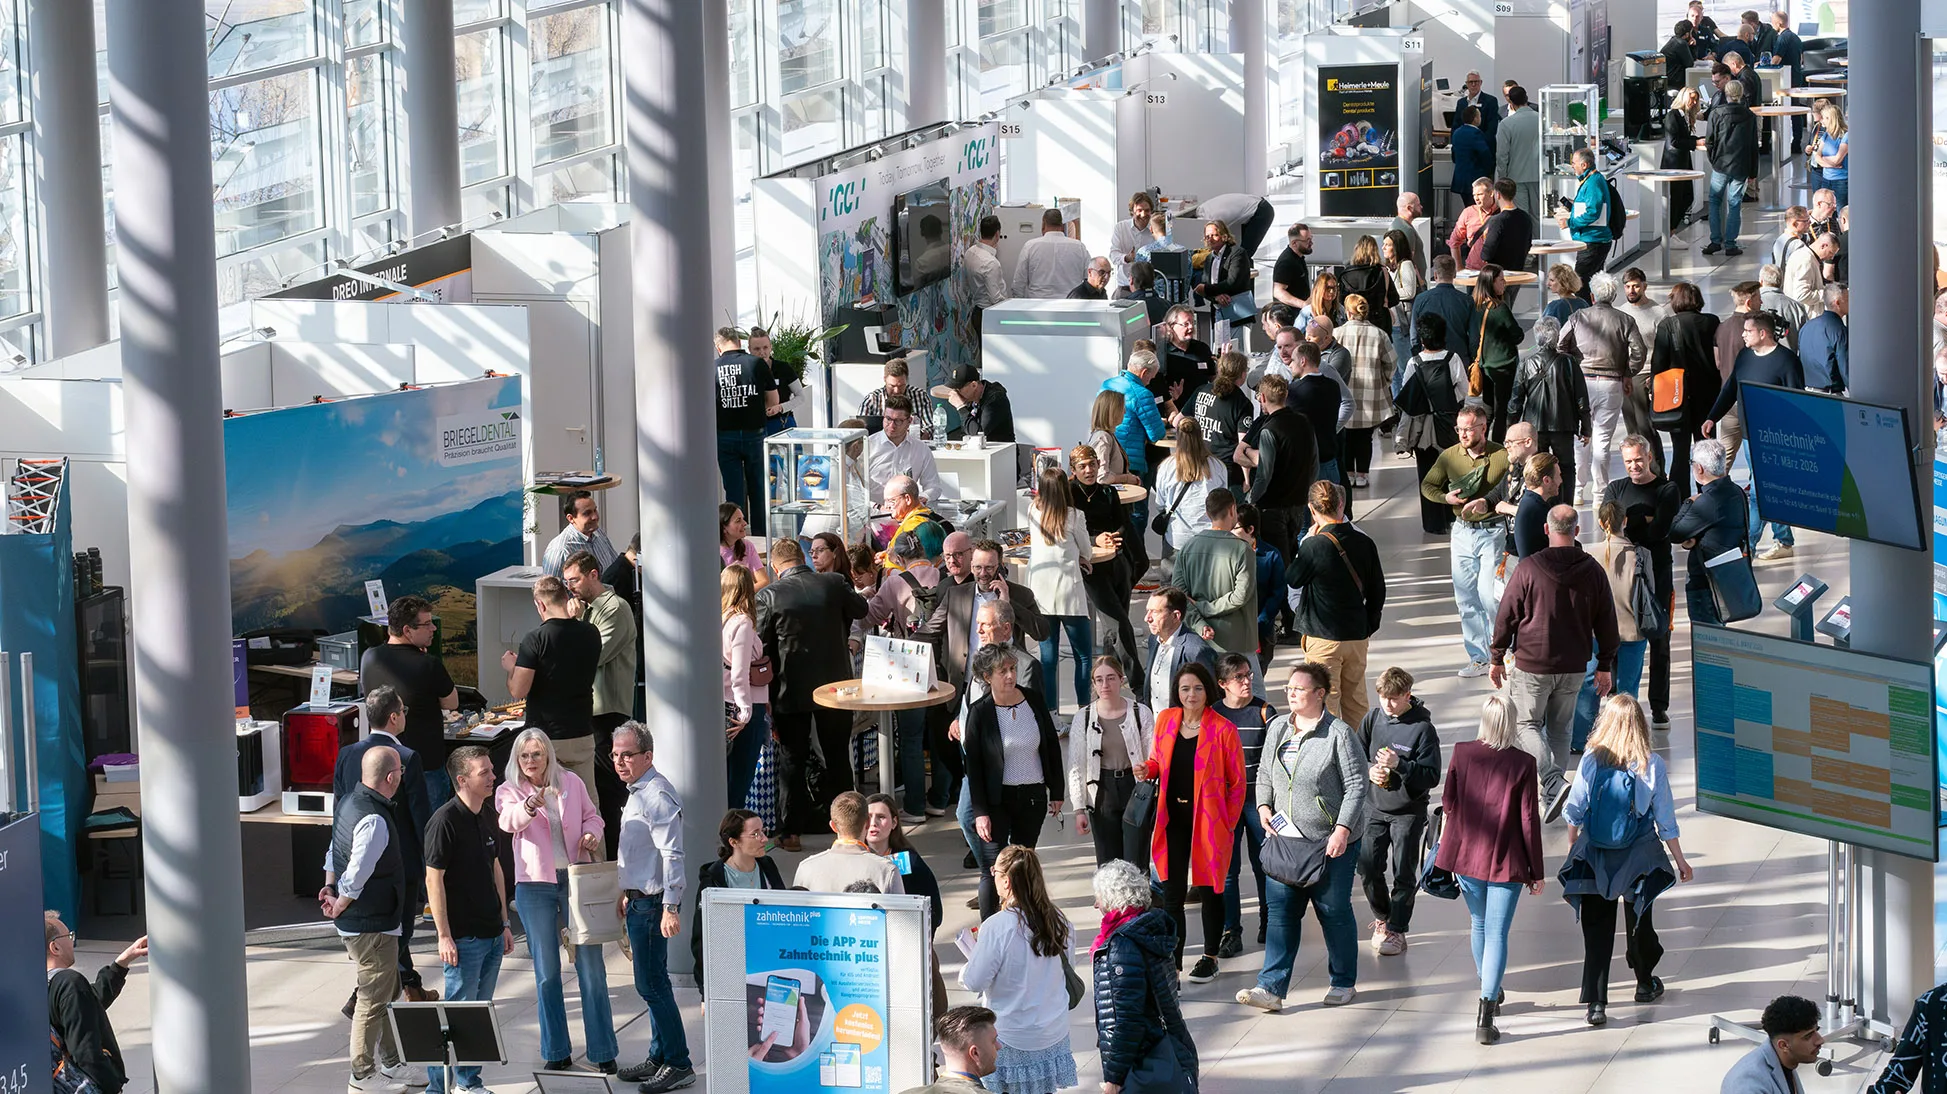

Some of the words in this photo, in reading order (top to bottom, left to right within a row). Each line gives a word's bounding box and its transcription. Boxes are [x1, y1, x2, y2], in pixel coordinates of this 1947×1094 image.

[1496, 4, 1511, 12] S09
[1147, 95, 1166, 104] S13
[1001, 125, 1020, 134] S15
[333, 280, 358, 300] DREO
[718, 364, 742, 377] HIGH
[719, 376, 736, 388] END
[720, 384, 758, 398] DIGITAL
[722, 396, 748, 408] SMILE
[1195, 392, 1216, 407] HIGH
[1194, 403, 1208, 416] END
[444, 421, 516, 448] BRIEGELDENTAL
[1758, 428, 1815, 451] zahntechnik
[1814, 434, 1826, 445] plus
[444, 450, 470, 460] Präzision
[472, 446, 494, 456] braucht
[494, 442, 516, 452] Qualität
[1780, 456, 1798, 470] März
[1800, 458, 1819, 473] 2026
[756, 910, 810, 923] zahntechnik
[810, 936, 829, 946] Die
[832, 936, 856, 947] APP
[860, 940, 879, 948] zur
[779, 949, 852, 962] Zahntechnik
[854, 952, 879, 964] plus
[852, 1011, 868, 1020] Jetzt
[845, 1018, 873, 1030] kostenlos
